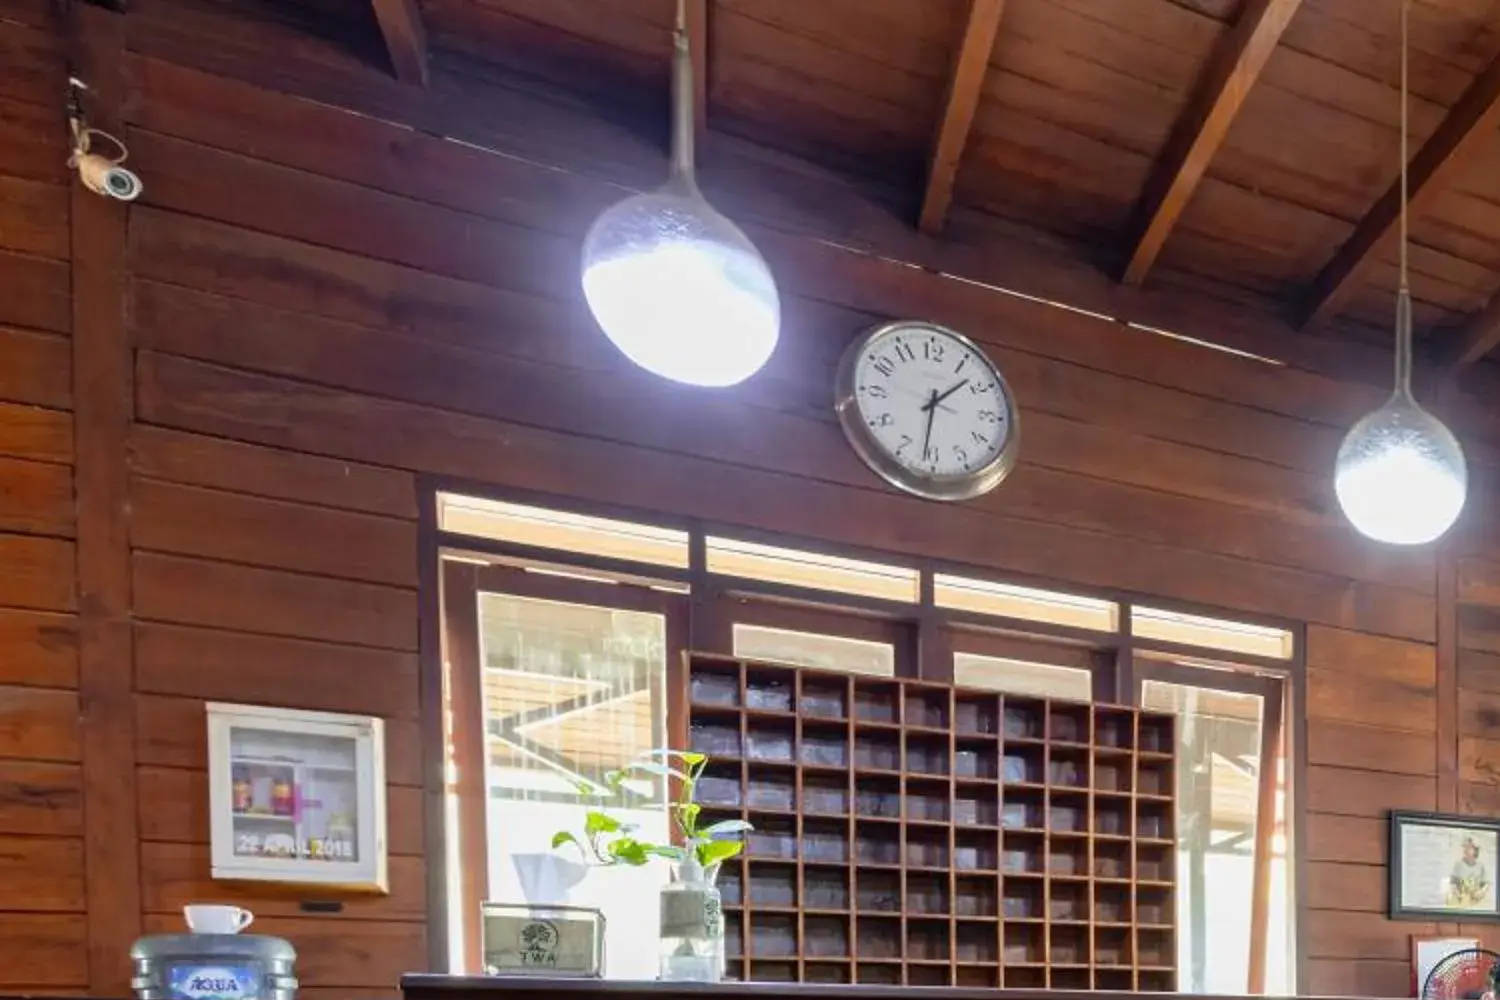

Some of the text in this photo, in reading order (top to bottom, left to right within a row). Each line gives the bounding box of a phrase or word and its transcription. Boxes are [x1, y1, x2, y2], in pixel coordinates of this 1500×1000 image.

[895, 342, 915, 363] 11
[924, 341, 944, 363] 12
[873, 356, 896, 378] 10
[954, 358, 965, 375] 1
[869, 385, 888, 399] 9
[876, 411, 895, 427] 8
[978, 409, 996, 424] 3
[900, 434, 914, 450] 7
[971, 430, 989, 445] 4
[952, 445, 967, 462] 5
[189, 976, 239, 992] AQUA
